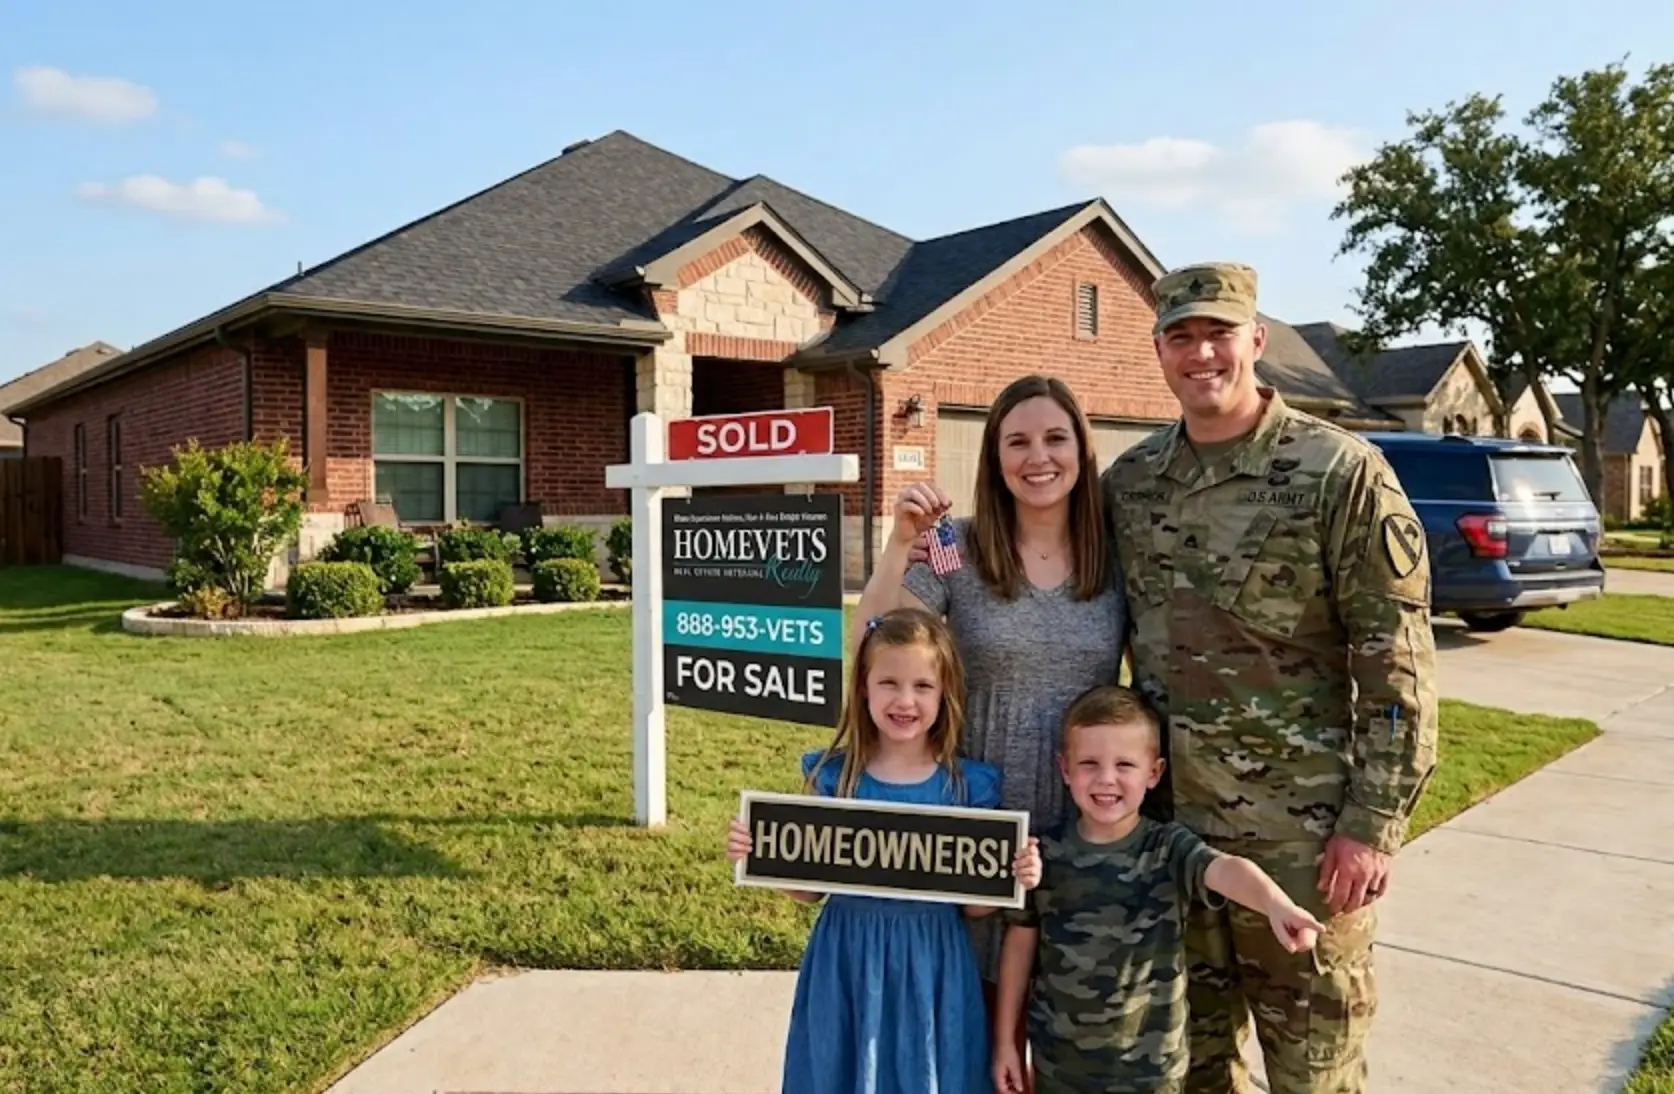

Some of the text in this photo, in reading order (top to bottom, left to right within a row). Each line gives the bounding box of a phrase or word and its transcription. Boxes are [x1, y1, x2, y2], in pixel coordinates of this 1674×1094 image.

[697, 419, 797, 455] SOLD
[673, 527, 827, 563] HOMEVETS
[676, 611, 824, 645] 888-953-VETS
[677, 655, 826, 704] FOR SALE
[755, 819, 1009, 879] HOMEOWNERS!
